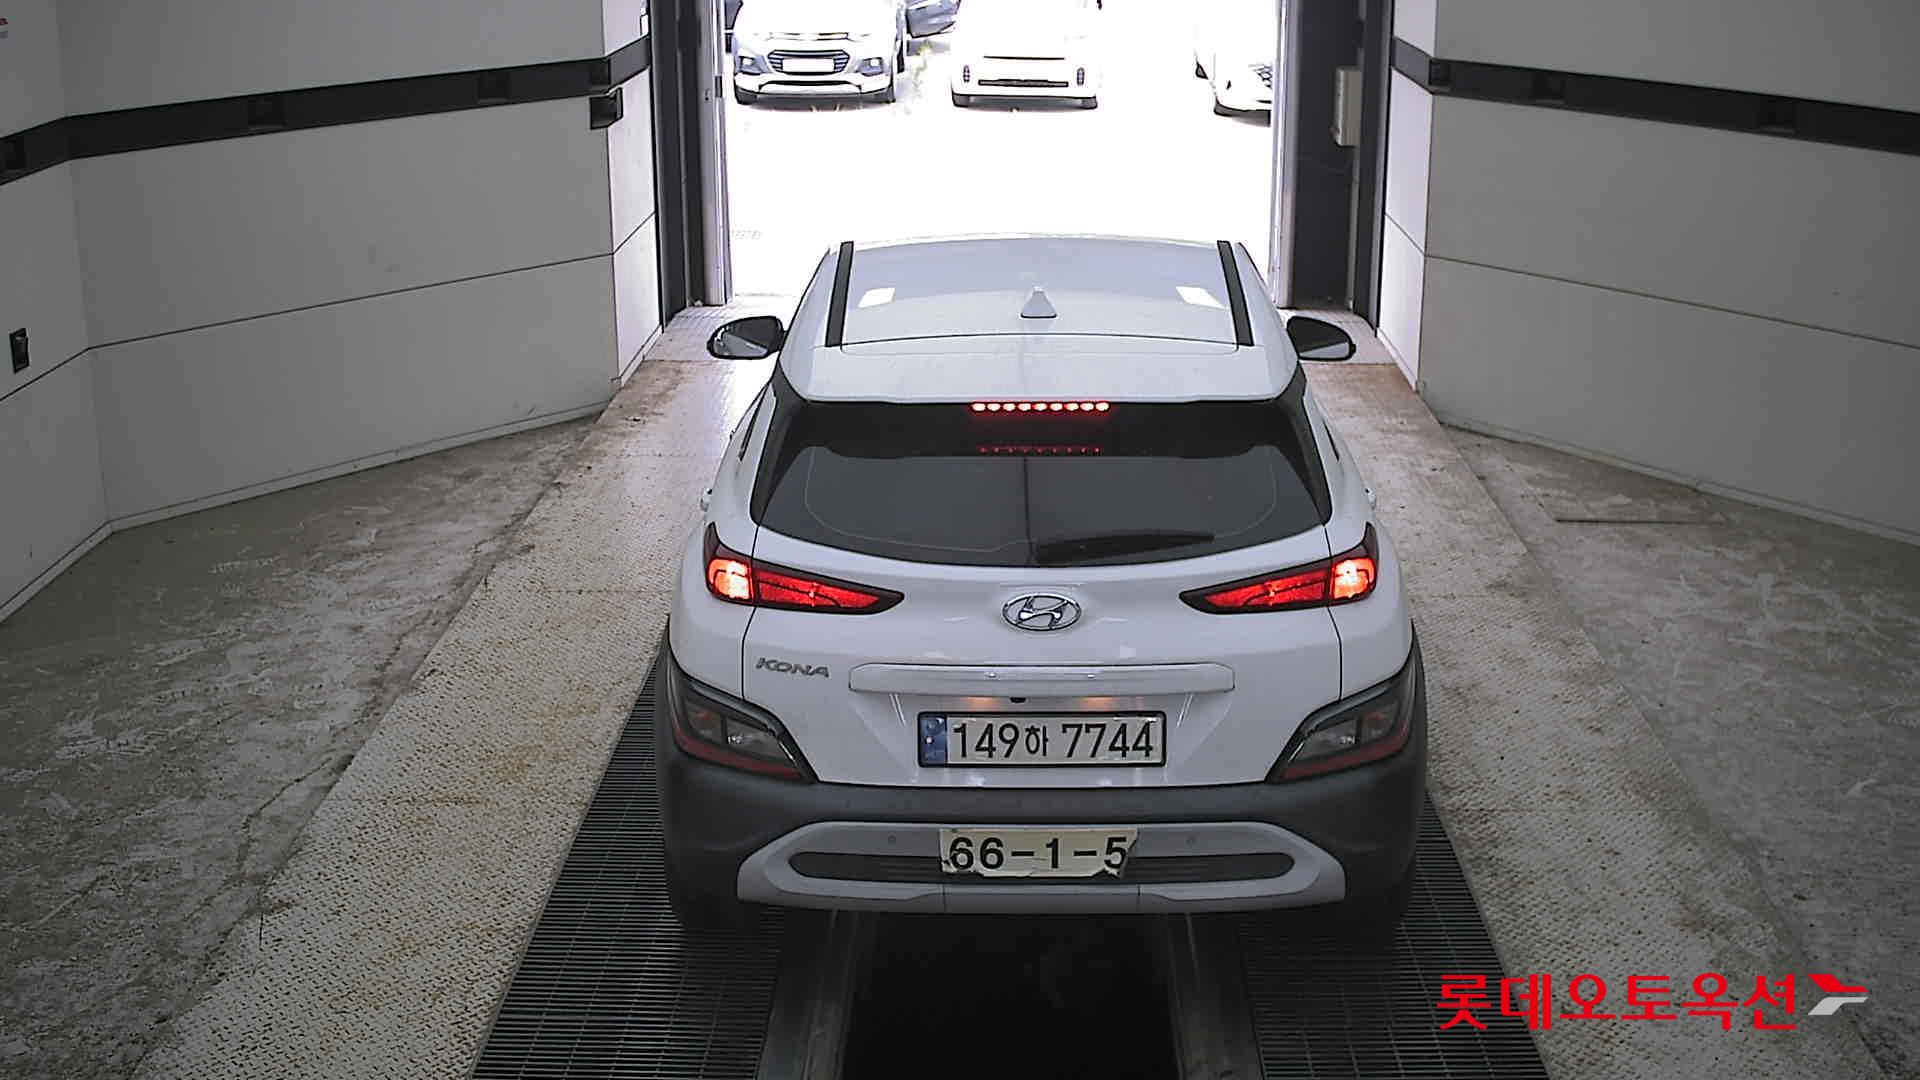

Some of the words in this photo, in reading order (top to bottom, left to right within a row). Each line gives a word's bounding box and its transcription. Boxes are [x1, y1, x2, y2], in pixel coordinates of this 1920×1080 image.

[755, 657, 830, 678] KONA
[952, 722, 1049, 759] 149하
[1061, 722, 1153, 759] 7744
[949, 836, 1128, 870] 66-1-5
